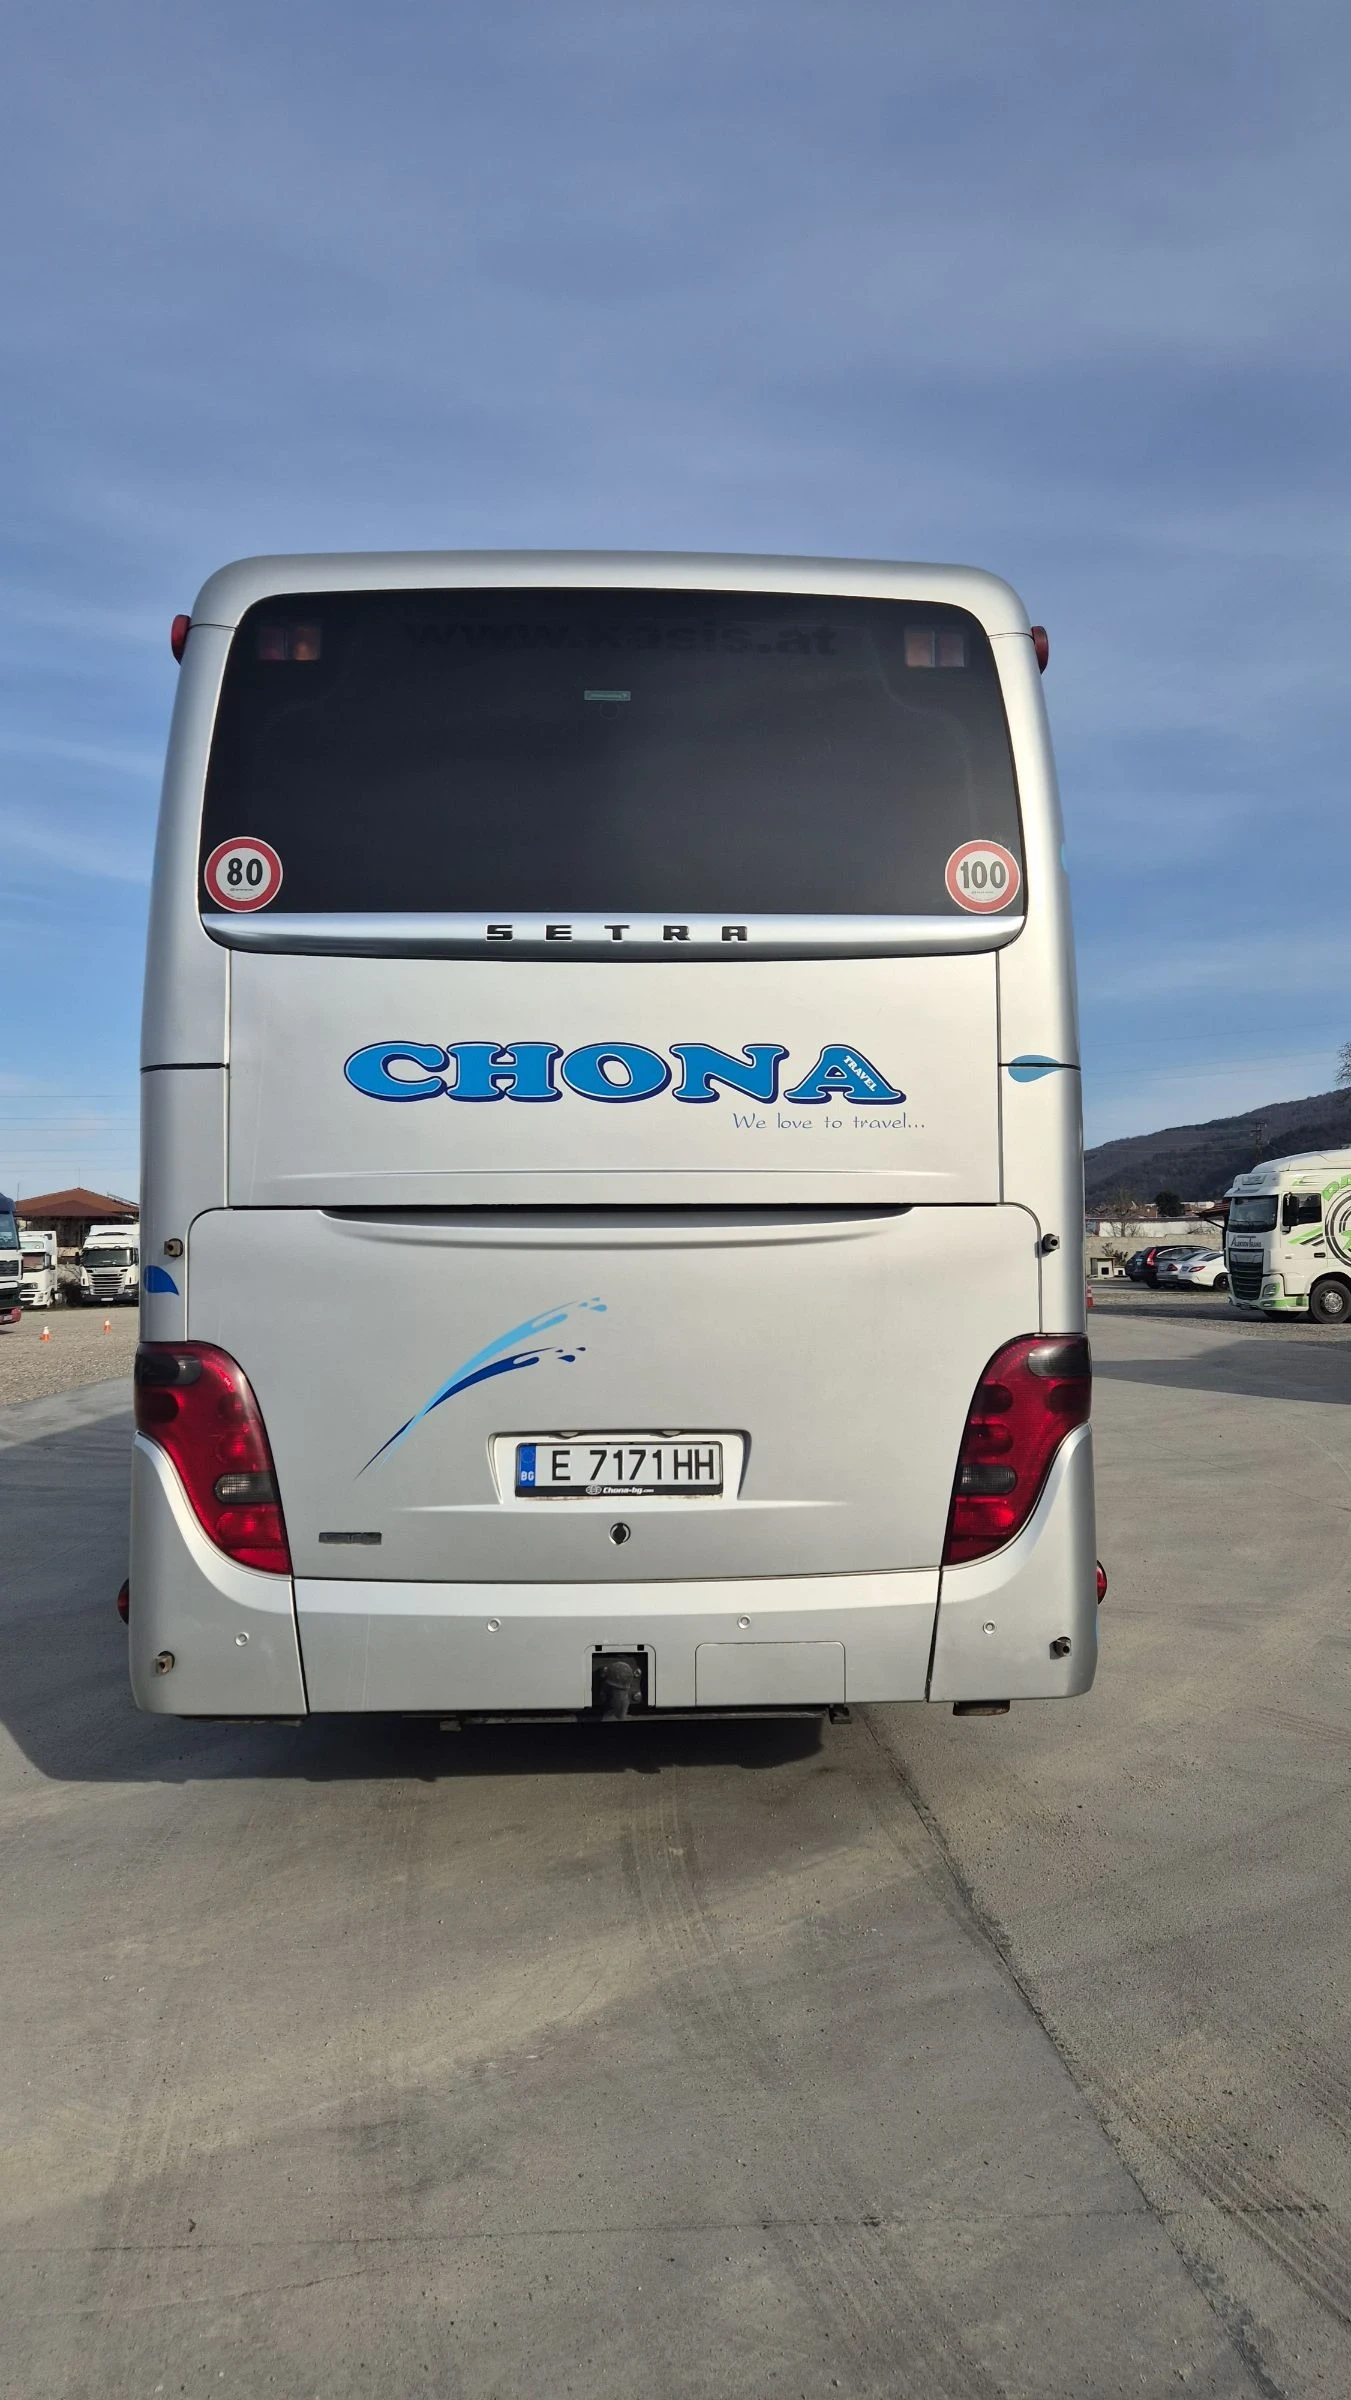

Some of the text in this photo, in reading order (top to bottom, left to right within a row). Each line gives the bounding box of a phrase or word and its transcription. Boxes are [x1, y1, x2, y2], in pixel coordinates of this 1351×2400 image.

[227, 858, 263, 886] 80
[961, 861, 1006, 889] 100
[486, 924, 748, 942] SETRA
[344, 1040, 907, 1105] CHONA
[843, 1055, 877, 1092] TRAVEL
[733, 1112, 925, 1129] We love to travel...
[521, 1471, 534, 1481] BG
[552, 1450, 571, 1481] E
